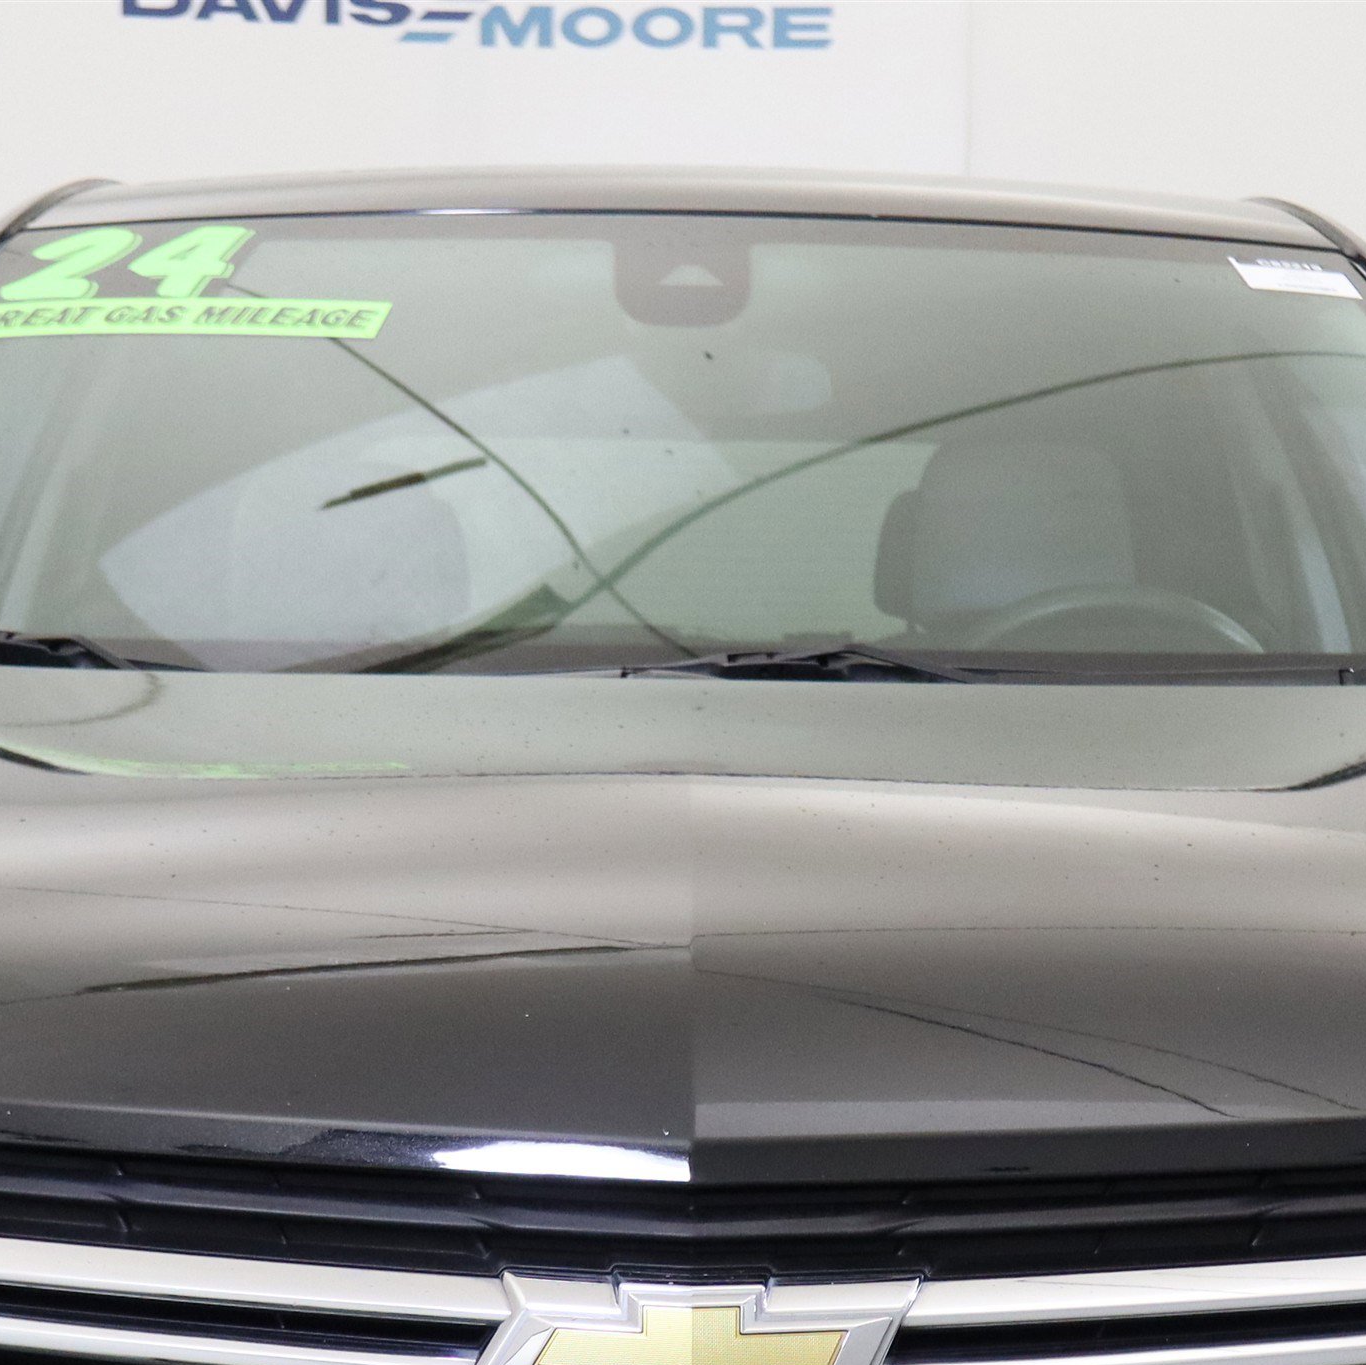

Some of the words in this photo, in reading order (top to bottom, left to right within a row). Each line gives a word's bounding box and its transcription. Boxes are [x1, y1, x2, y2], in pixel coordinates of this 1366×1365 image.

[479, 6, 834, 51] MOORE
[0, 225, 256, 300] 24
[104, 304, 188, 326] GAS
[192, 304, 381, 330] MILEAGE
